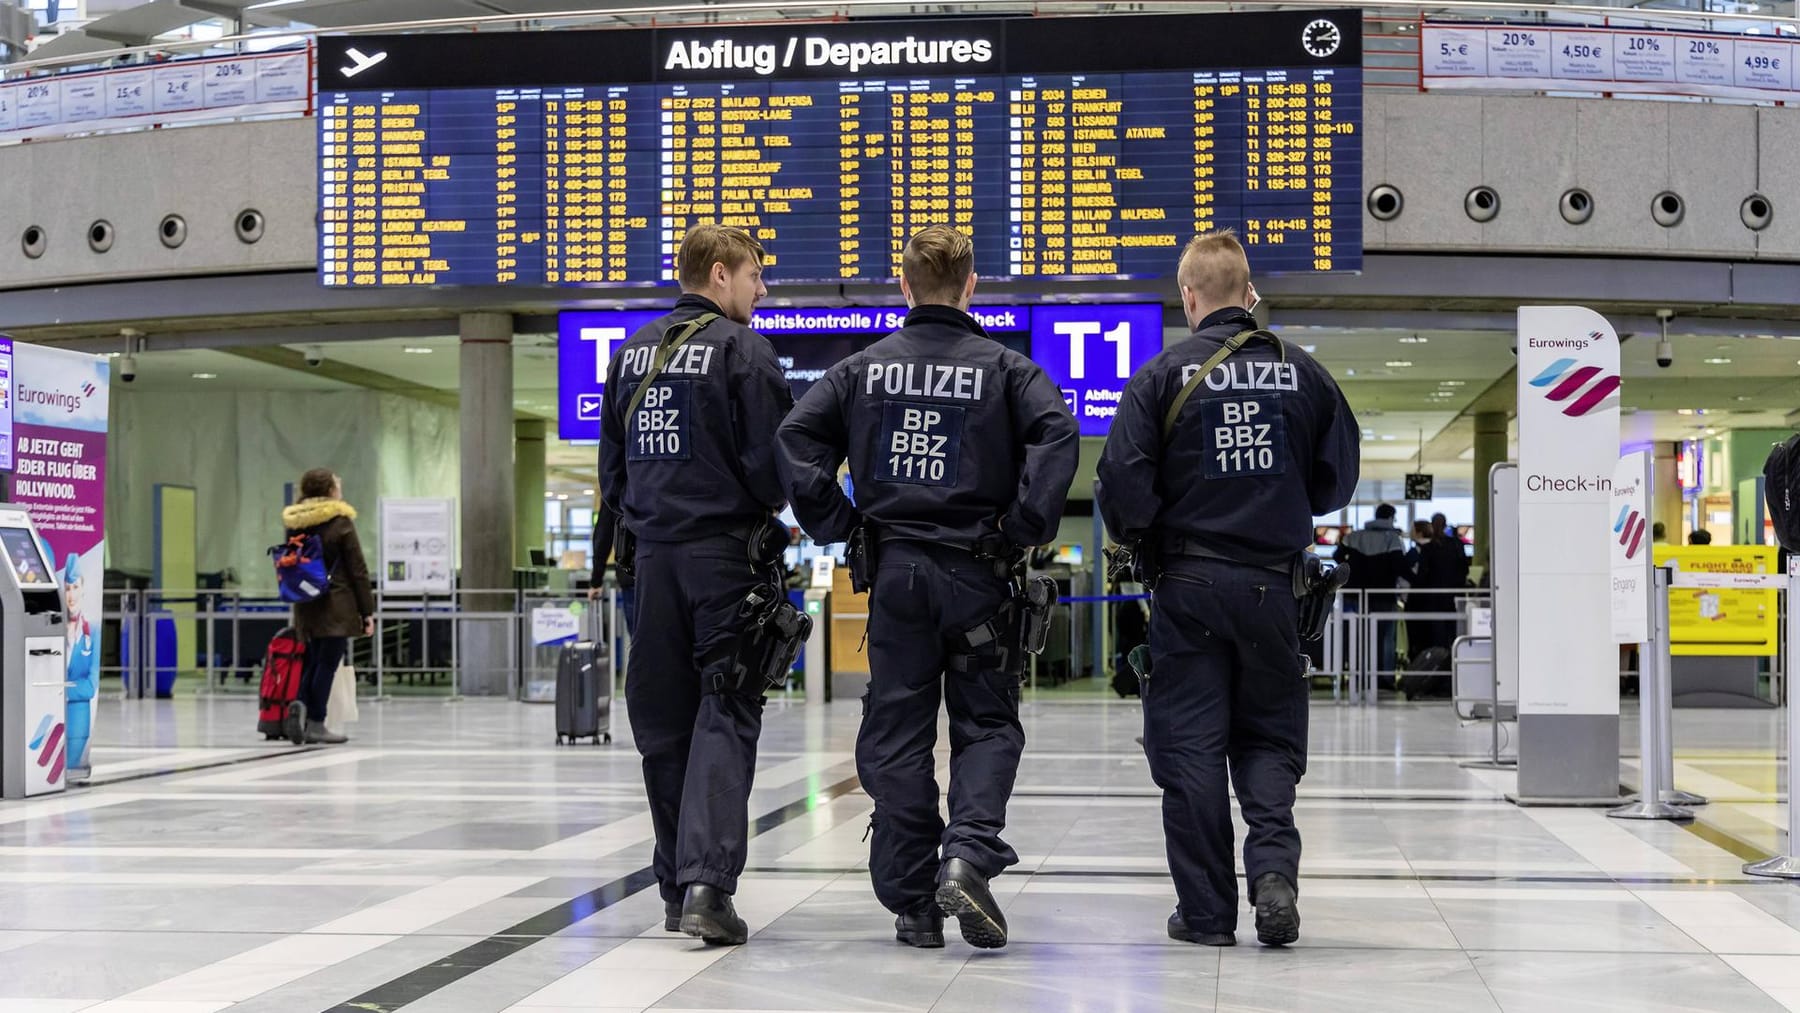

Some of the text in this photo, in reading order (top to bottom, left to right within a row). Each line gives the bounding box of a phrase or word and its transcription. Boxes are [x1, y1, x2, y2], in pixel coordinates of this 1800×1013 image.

[664, 36, 992, 75] Abflug / Departures
[1072, 102, 1122, 112] FRANKFURT
[1072, 116, 1118, 126] LISSABON
[1073, 129, 1117, 139] ISTANBUL
[1125, 128, 1165, 138] ATATURK
[1071, 156, 1116, 166] HELSINKI
[1071, 170, 1107, 180] BERLIN
[1071, 250, 1112, 260] ZUERICH
[1053, 321, 1131, 379] T1
[1528, 338, 1589, 350] Eurowings
[866, 363, 983, 400] POLIZEI
[18, 384, 81, 413] Eurowings
[644, 387, 672, 408] BP
[638, 409, 679, 431] BBZ
[903, 408, 941, 432] BP
[1223, 401, 1260, 424] BP
[638, 432, 680, 454] 1110
[891, 431, 948, 457] BBZ
[1214, 424, 1272, 448] BBZ
[17, 437, 84, 458] AB JETZT GEHT
[16, 458, 97, 481] JEDER FLUG ÜBER
[889, 454, 945, 480] 1110
[1216, 448, 1273, 472] 1110
[16, 480, 76, 499] HOLLYWOOD.
[1526, 475, 1612, 491] Check-in
